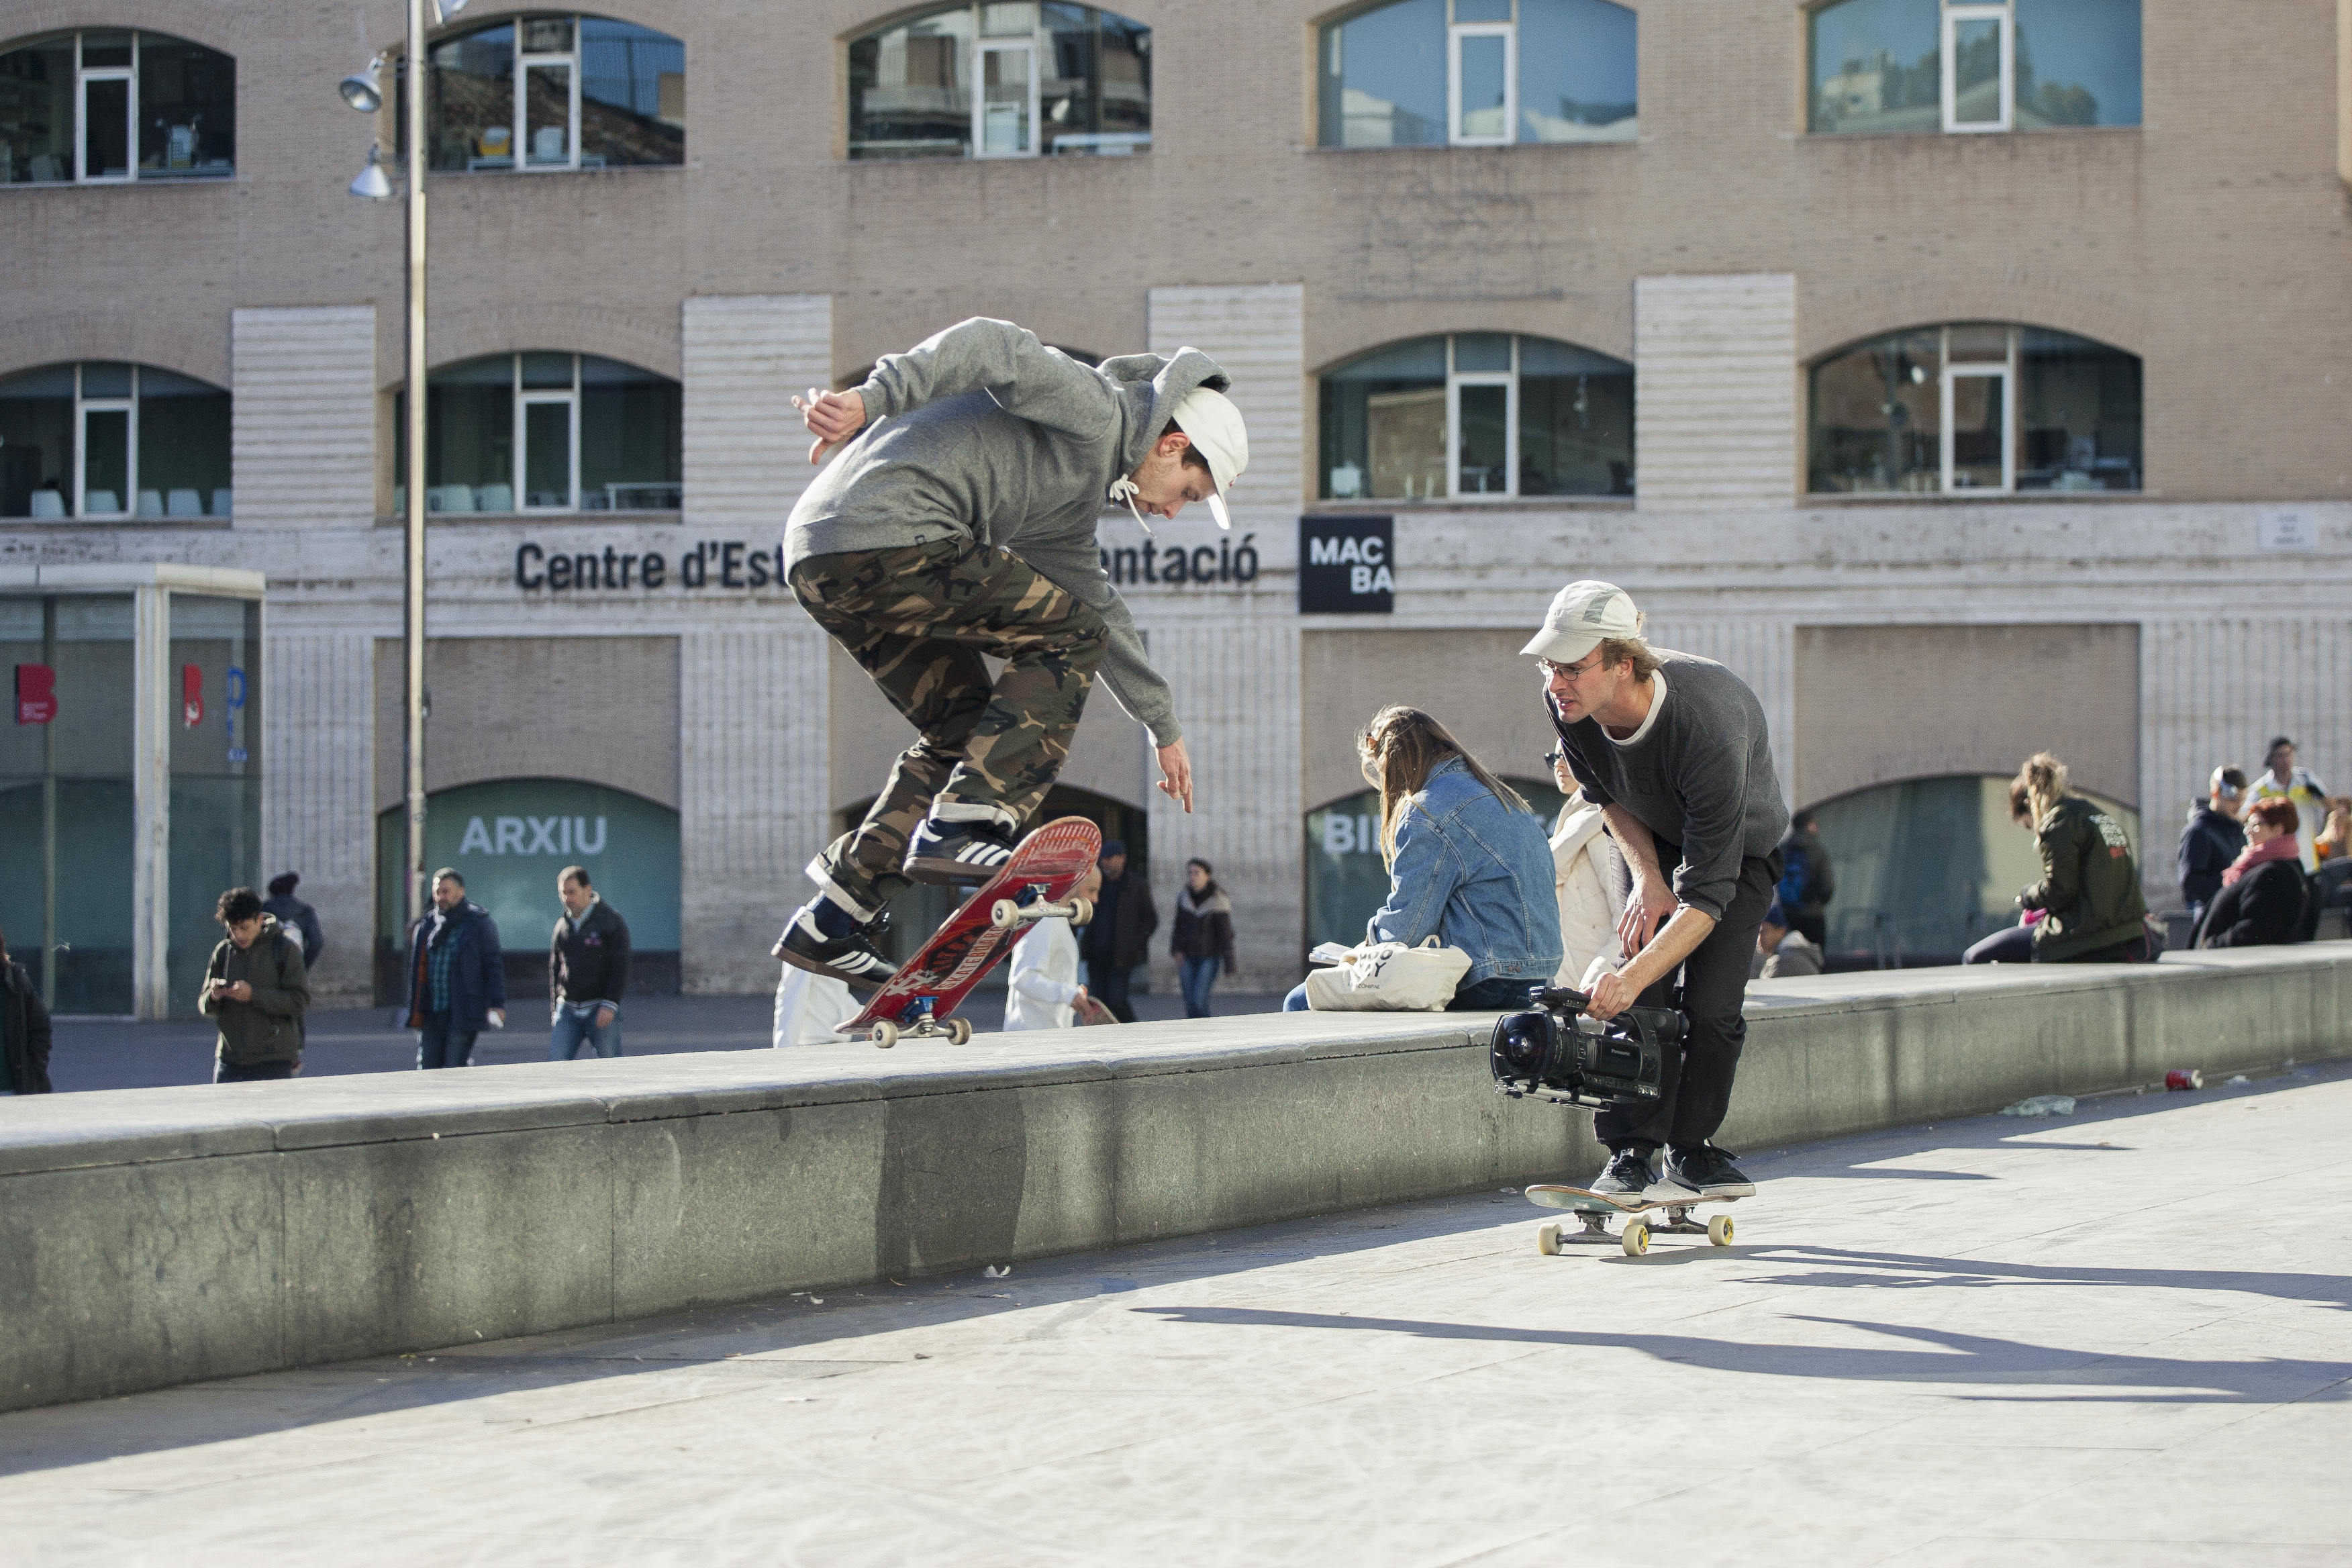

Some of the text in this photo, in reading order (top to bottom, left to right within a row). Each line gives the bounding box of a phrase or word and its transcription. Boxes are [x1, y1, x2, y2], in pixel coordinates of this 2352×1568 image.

[516, 541, 666, 589] Centre
[1310, 536, 1385, 565] MAC
[1351, 565, 1394, 593] BA
[459, 816, 607, 855] ARXIU
